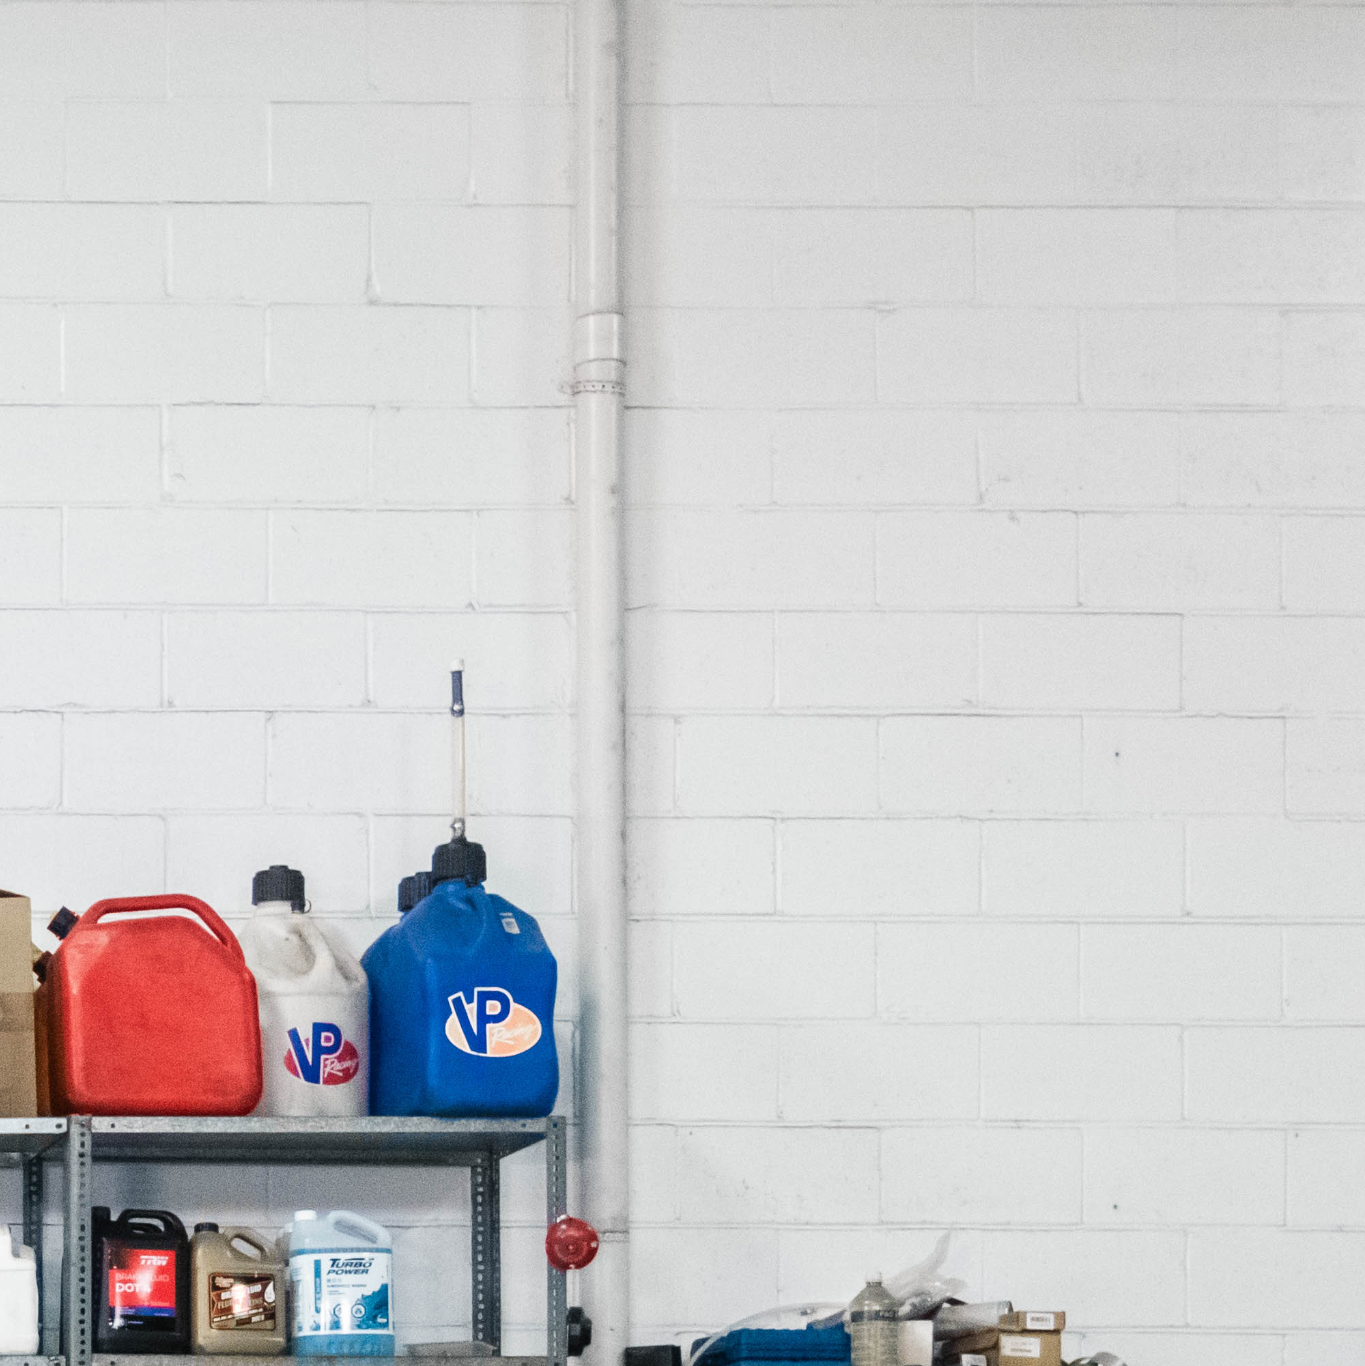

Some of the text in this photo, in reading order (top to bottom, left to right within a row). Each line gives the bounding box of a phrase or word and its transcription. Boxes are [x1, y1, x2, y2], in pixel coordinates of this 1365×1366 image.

[448, 987, 513, 1055] VP
[287, 1022, 342, 1086] VP
[140, 1256, 169, 1266] TRW
[329, 1258, 374, 1269] TURBO
